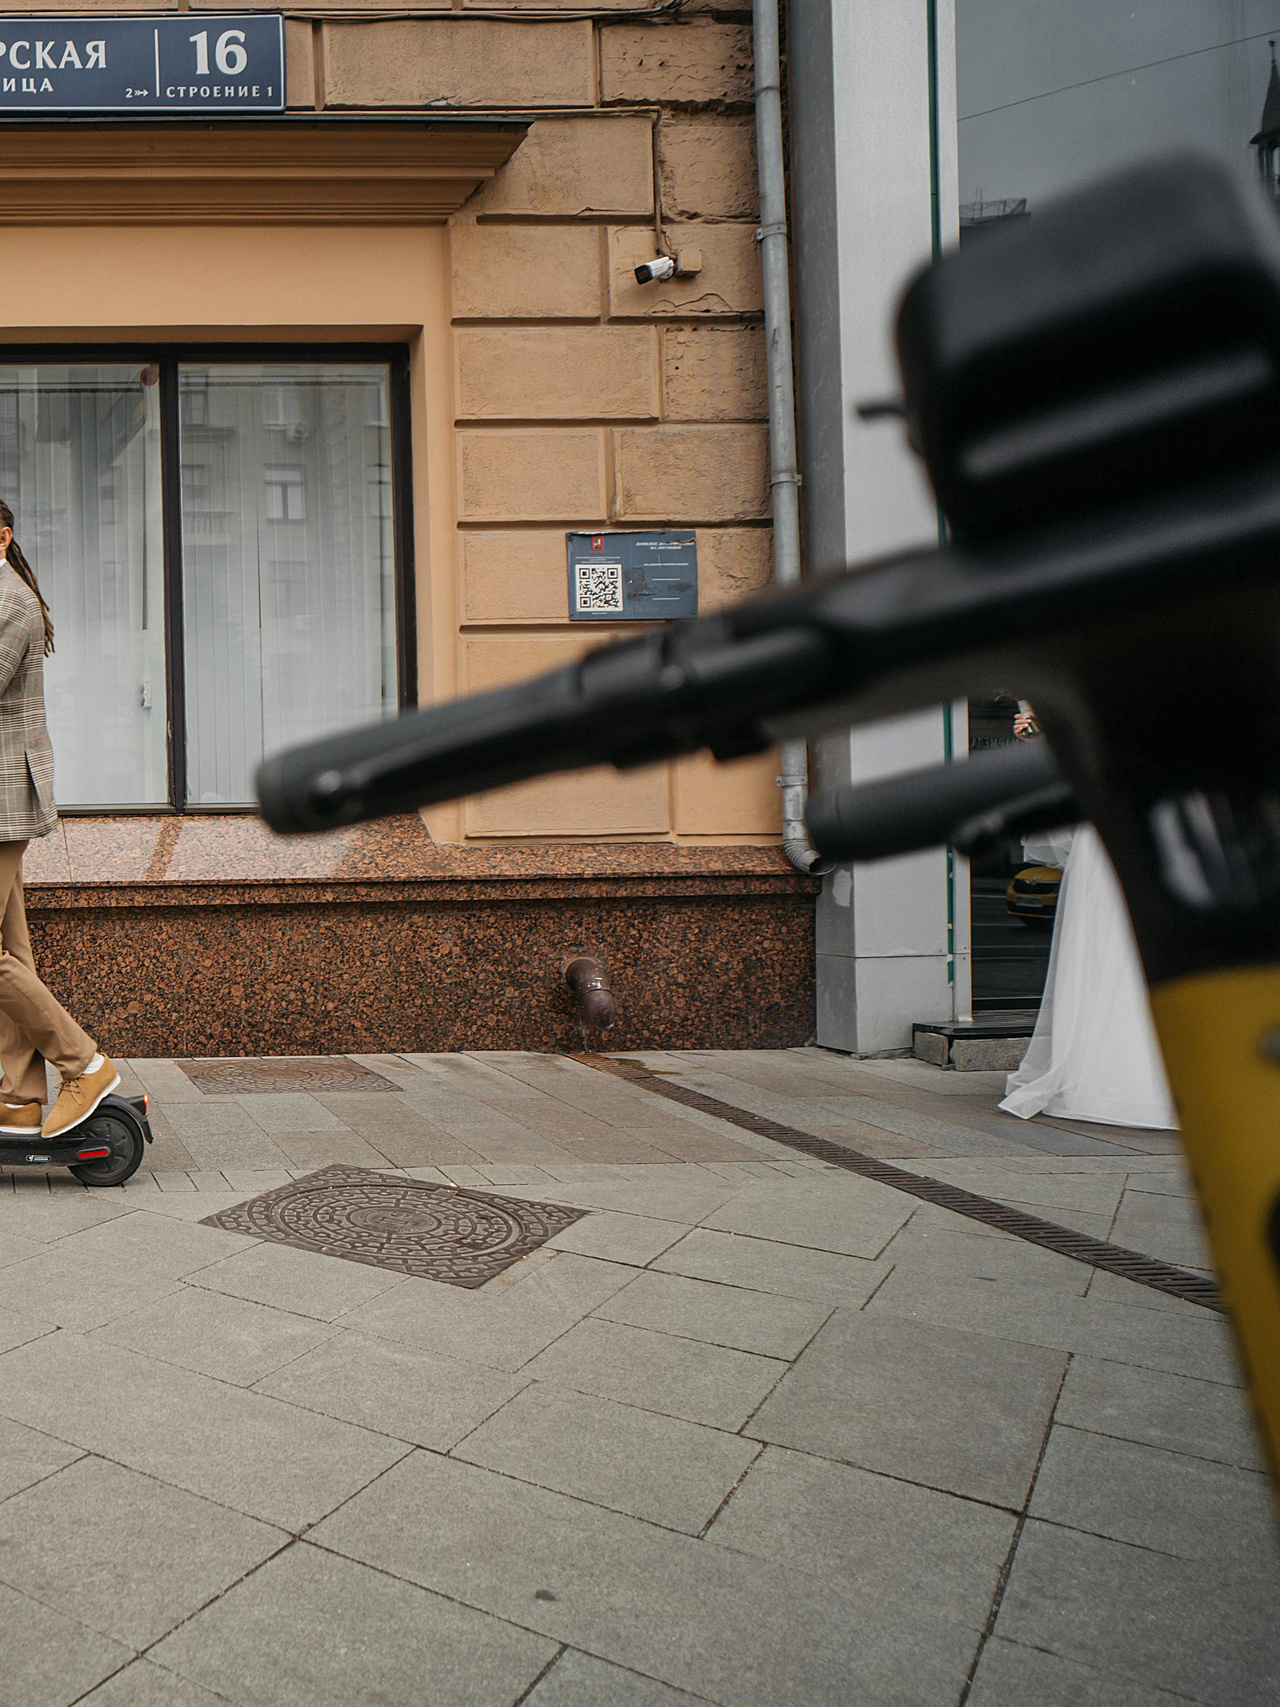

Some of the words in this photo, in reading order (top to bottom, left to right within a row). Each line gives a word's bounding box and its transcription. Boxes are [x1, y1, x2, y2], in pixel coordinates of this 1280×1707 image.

[189, 30, 248, 75] 16
[125, 88, 133, 98] 2
[166, 85, 261, 98] СТРОЕНИЕ
[267, 86, 273, 97] 1
